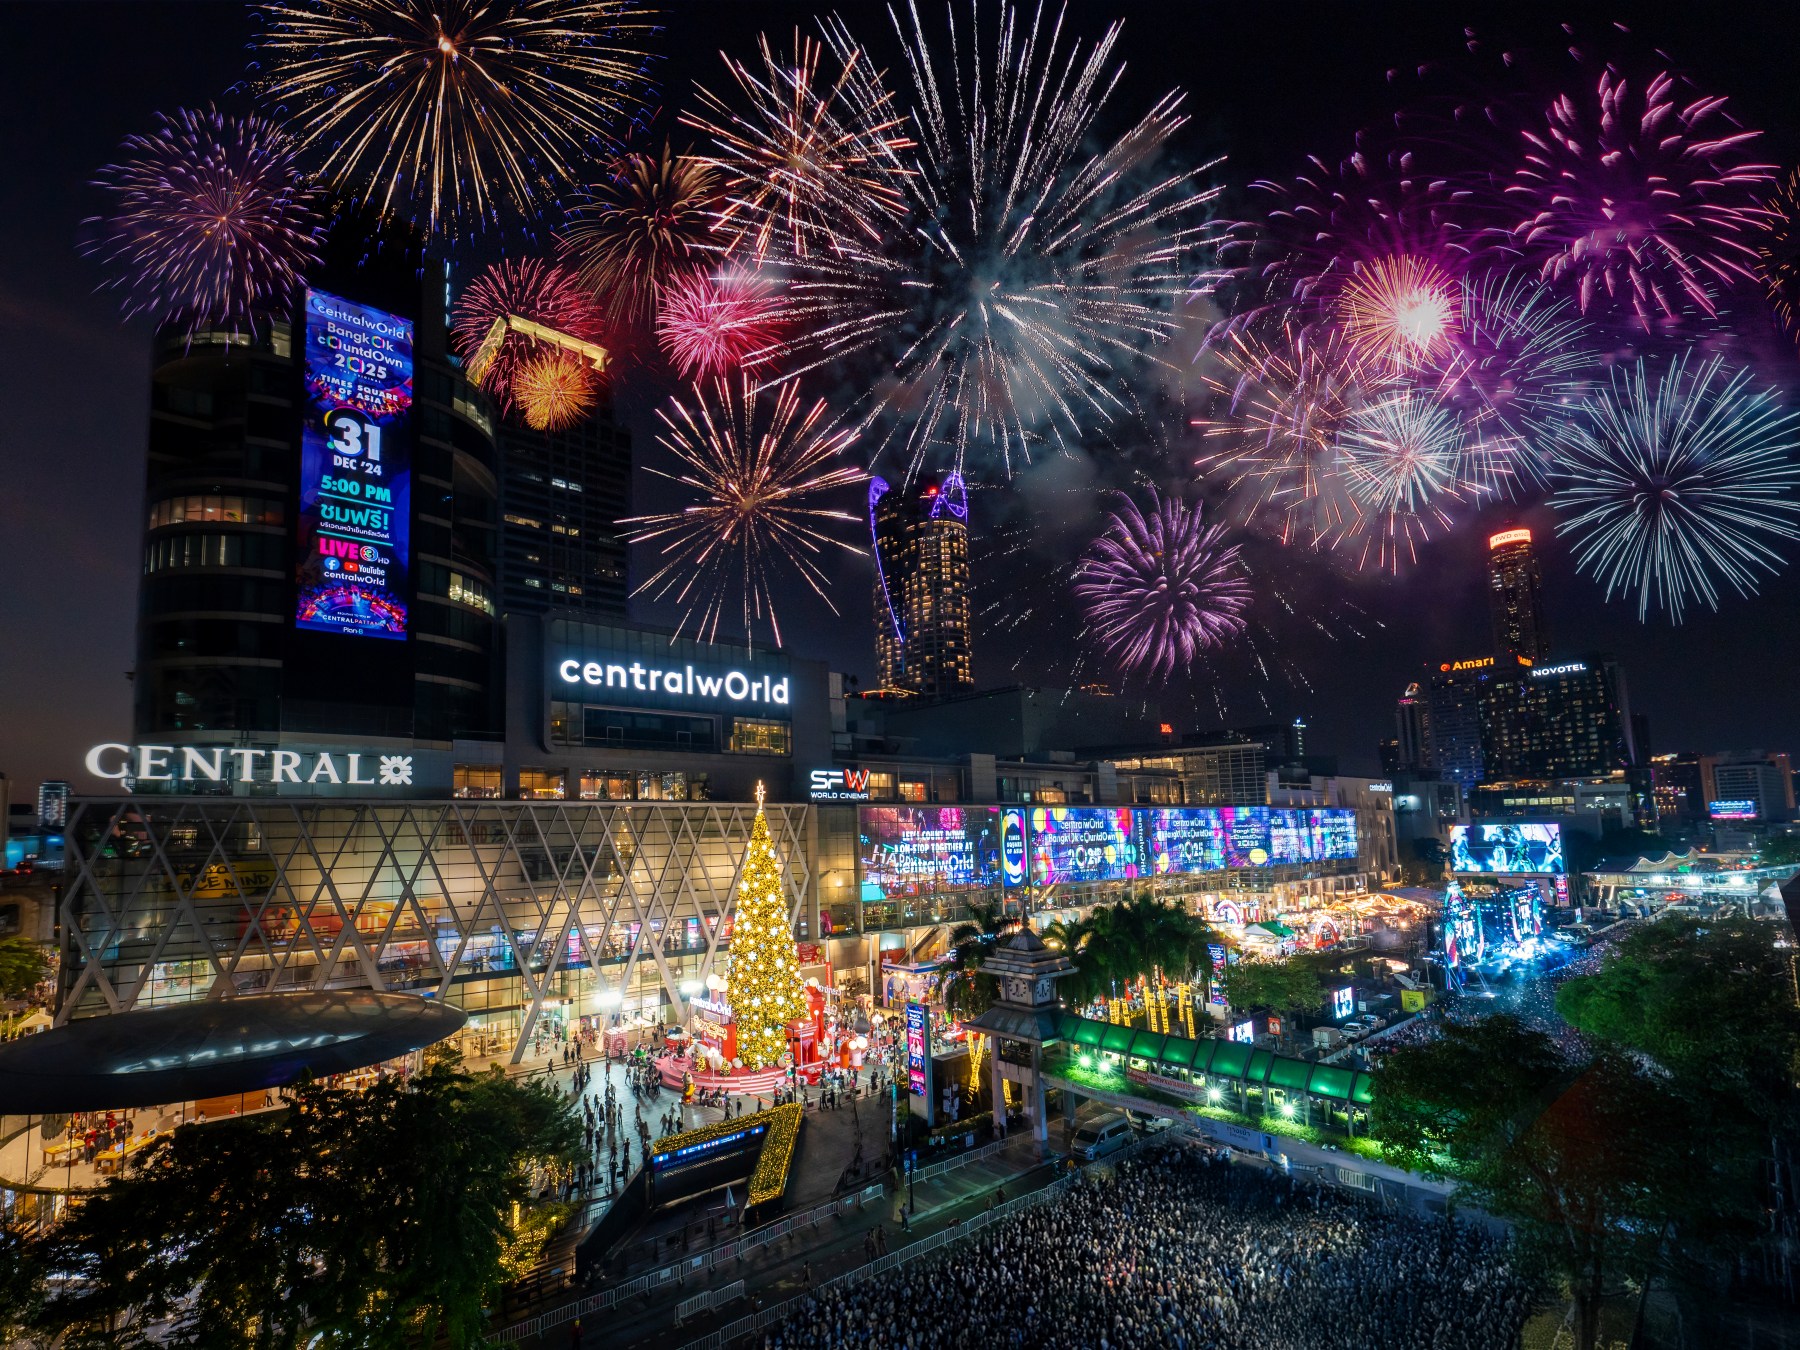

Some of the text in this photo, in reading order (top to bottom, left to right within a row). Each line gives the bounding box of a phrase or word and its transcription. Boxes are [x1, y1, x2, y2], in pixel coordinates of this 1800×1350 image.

[317, 304, 405, 340] centralwOrld
[334, 353, 387, 379] 2025
[320, 374, 399, 402] TIMES SQUARE
[338, 387, 353, 396] OF
[333, 417, 381, 461] 31
[333, 454, 357, 470] DEC
[321, 475, 392, 503] 5:00 PM
[320, 503, 389, 531] ชมฟรี!
[319, 537, 359, 560] LIVE
[377, 557, 390, 565] HD
[358, 564, 385, 576] YouTube
[1452, 657, 1495, 670] Amari
[1532, 663, 1587, 677] NOVOTEL
[559, 659, 790, 705] centralwOrld
[85, 743, 375, 788] CENTRAL
[810, 791, 838, 799] WORLD
[921, 830, 944, 841] COUNT
[945, 829, 966, 840] DOWN
[964, 842, 973, 851] AT
